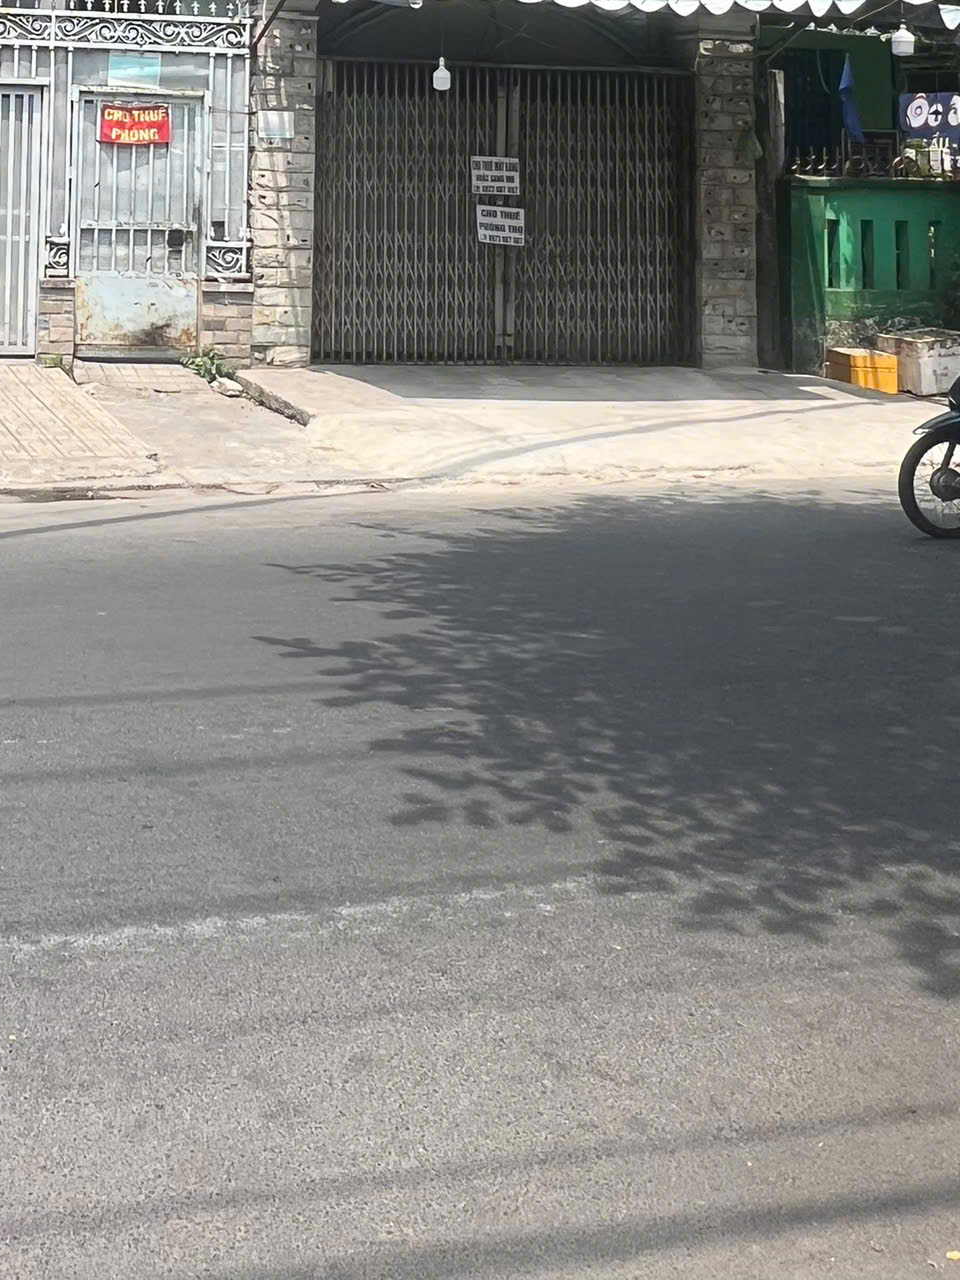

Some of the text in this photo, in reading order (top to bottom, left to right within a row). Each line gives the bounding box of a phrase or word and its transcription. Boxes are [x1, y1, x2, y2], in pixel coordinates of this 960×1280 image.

[104, 108, 130, 122] CHO
[111, 127, 159, 141] PHÒNG
[481, 209, 520, 220] CHO THUÊ
